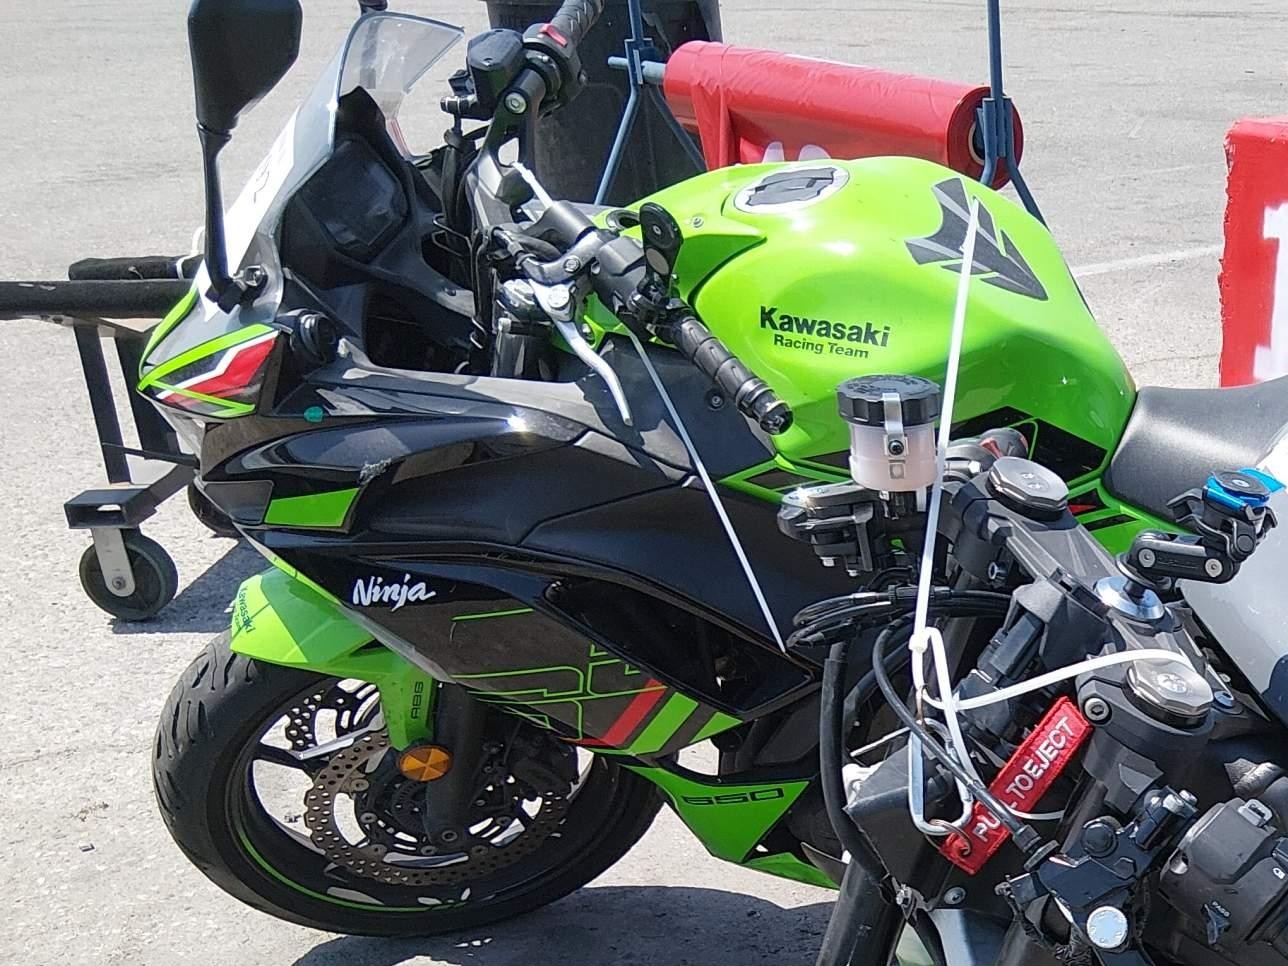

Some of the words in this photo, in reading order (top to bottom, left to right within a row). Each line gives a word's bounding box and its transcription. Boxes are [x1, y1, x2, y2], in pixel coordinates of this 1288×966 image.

[760, 305, 891, 347] Kawasaki
[773, 333, 824, 355] Racing
[828, 342, 869, 359] Team
[352, 573, 436, 612] Ninja
[411, 681, 424, 719] ABS
[681, 788, 785, 806] 650
